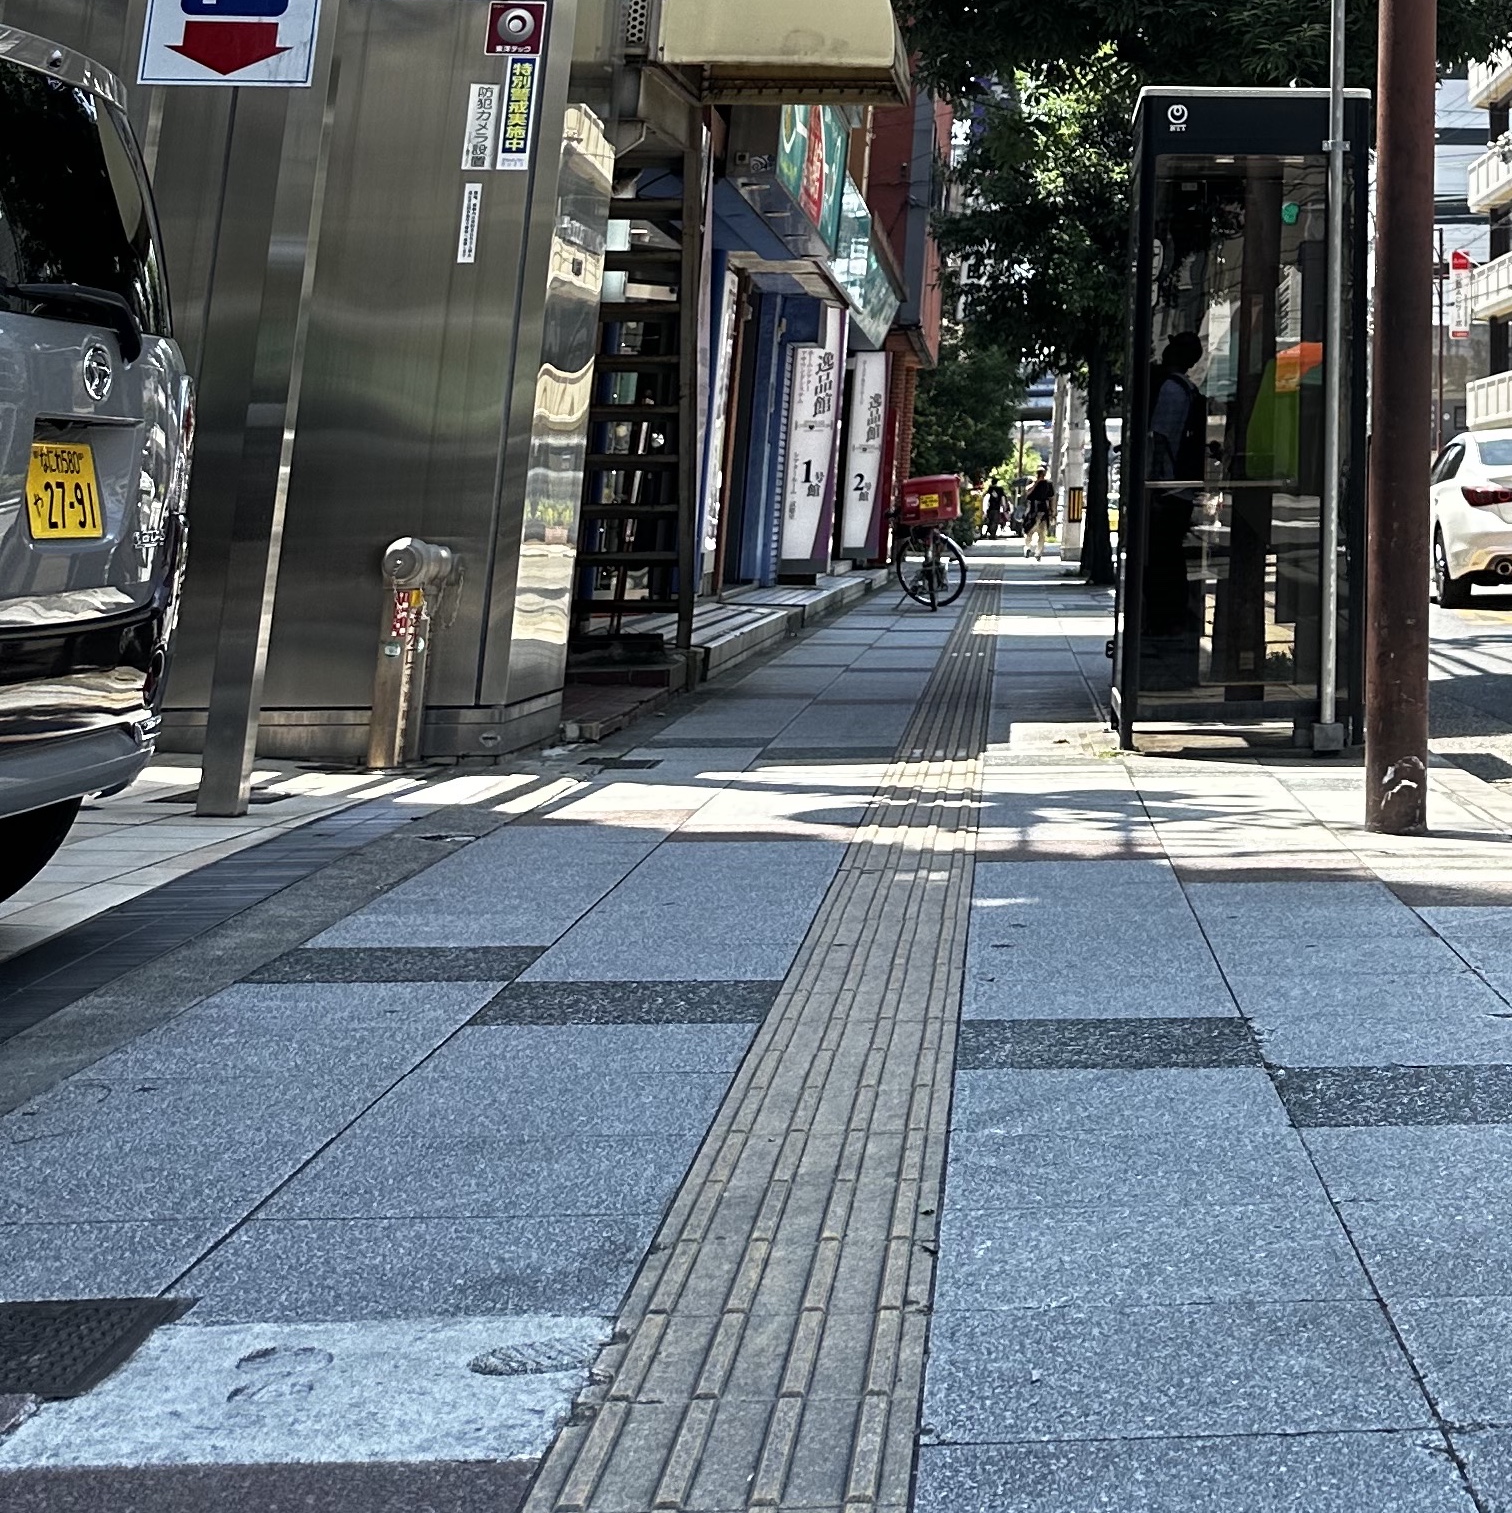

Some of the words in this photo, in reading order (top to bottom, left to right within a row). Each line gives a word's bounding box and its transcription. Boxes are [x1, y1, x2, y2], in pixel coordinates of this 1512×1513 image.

[470, 86, 495, 168] 防犯カメラ設置
[43, 481, 97, 529] 27-91
